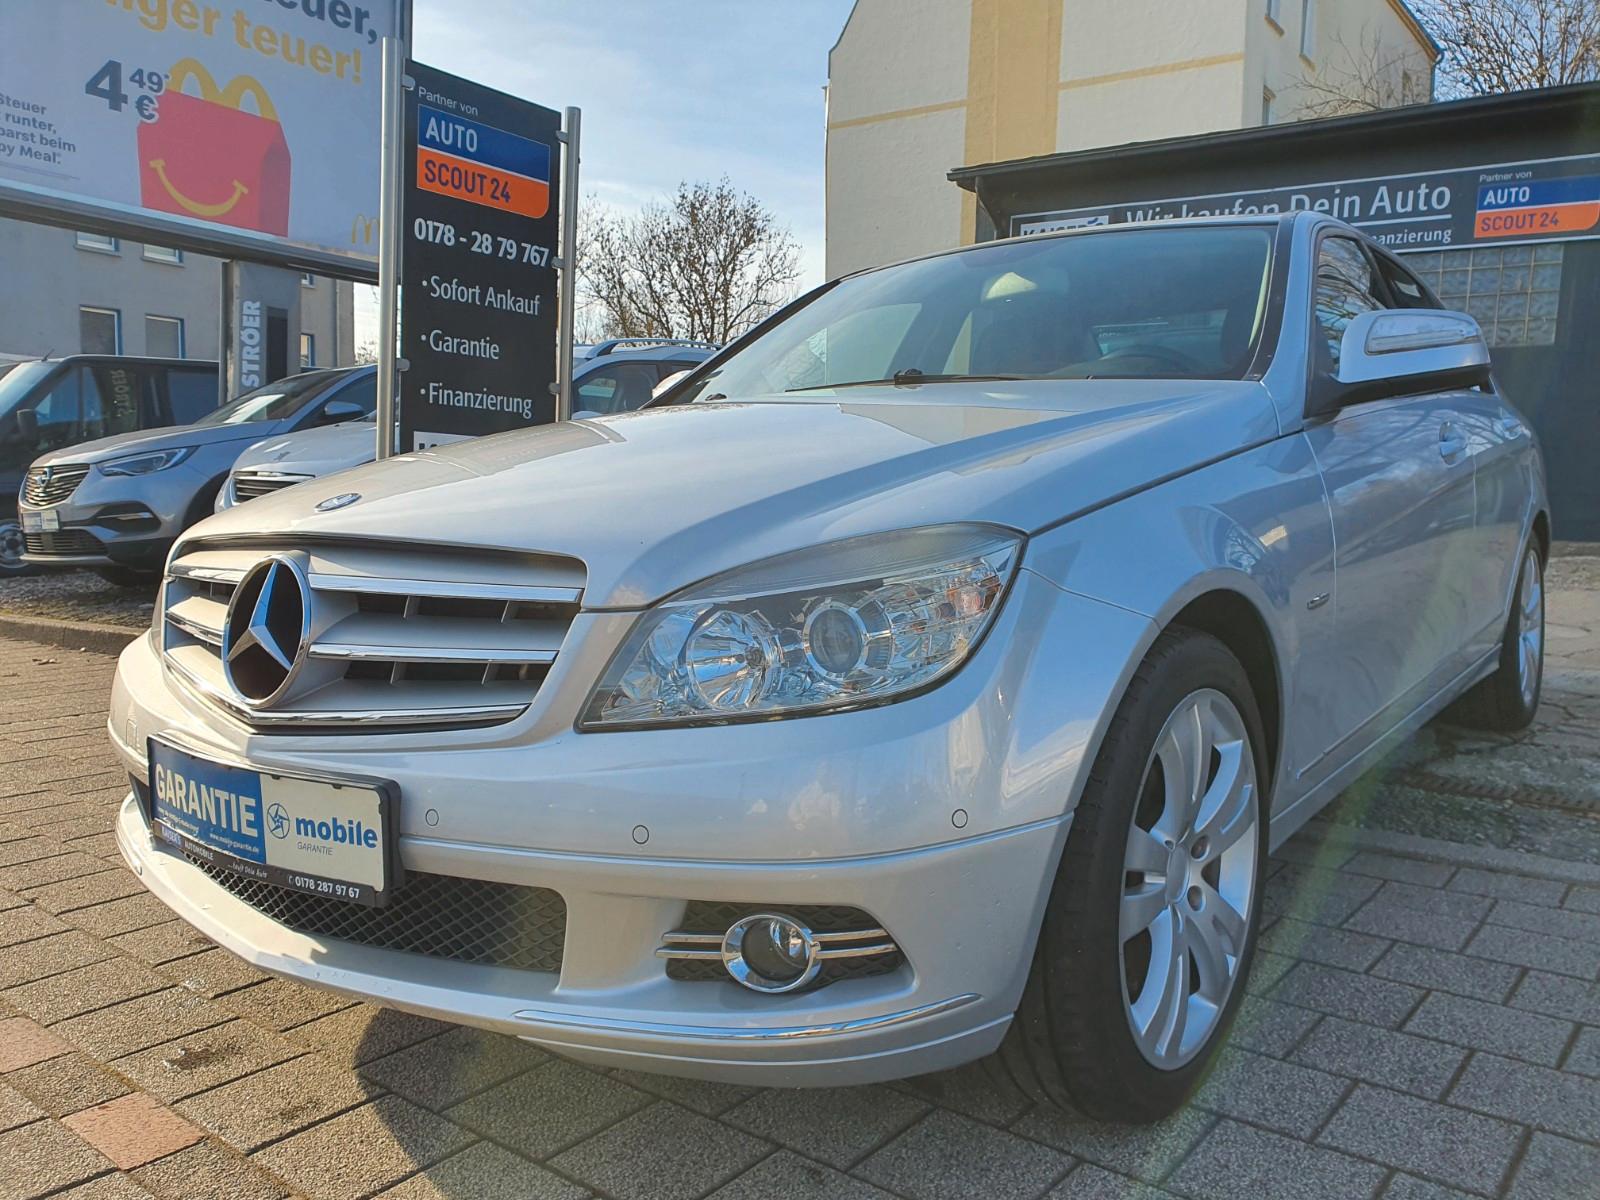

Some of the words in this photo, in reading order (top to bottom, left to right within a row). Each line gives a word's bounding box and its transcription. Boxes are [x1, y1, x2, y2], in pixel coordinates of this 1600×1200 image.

[231, 8, 362, 84] teuer!
[85, 60, 128, 112] 4
[418, 87, 457, 109] Partner
[460, 103, 478, 116] von
[5, 112, 57, 134] runter,
[136, 95, 156, 120] €
[39, 133, 76, 152] beim
[425, 117, 478, 152] AUTO
[1480, 173, 1512, 182] Partner
[1515, 171, 1532, 179] von
[1290, 187, 1360, 219] Dein
[1370, 183, 1451, 216] Auto
[1483, 186, 1530, 206] AUTO
[414, 218, 455, 246] 0178
[471, 231, 493, 254] 28
[497, 237, 517, 260] 79
[521, 242, 549, 267] 767
[430, 275, 480, 307] Sofort
[485, 286, 540, 315] Ankauf
[240, 300, 261, 388] STRÖER
[429, 329, 499, 360] Garantie
[428, 382, 532, 419] Finanzierung
[155, 763, 258, 838] GARANTIE
[295, 817, 378, 849] mobile
[297, 842, 334, 856] GARANTIE
[295, 876, 316, 890] 0178
[317, 880, 334, 894] 287
[335, 885, 347, 897] 97
[348, 887, 361, 899] 67
